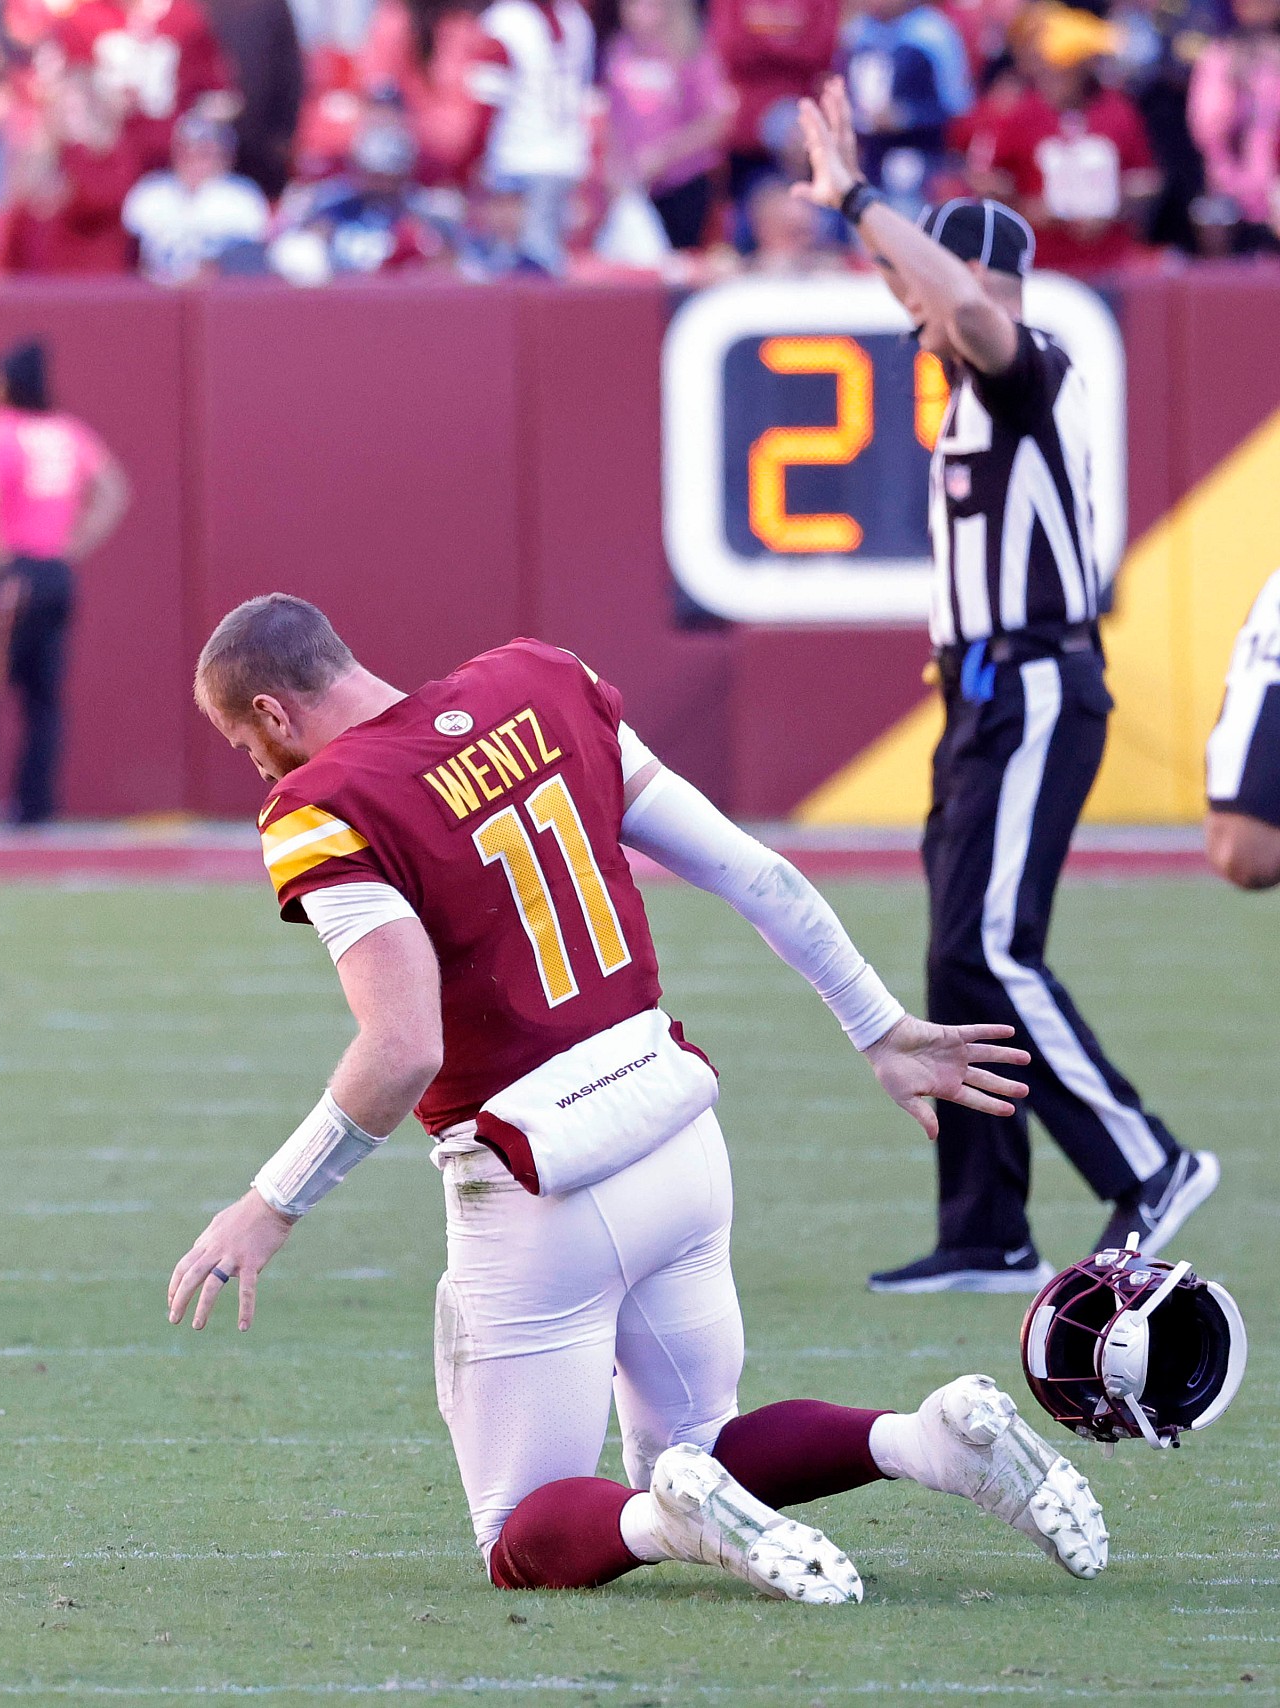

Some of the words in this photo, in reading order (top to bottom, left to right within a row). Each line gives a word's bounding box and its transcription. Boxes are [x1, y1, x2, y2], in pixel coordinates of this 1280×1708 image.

[423, 708, 562, 820] WENTZ
[471, 773, 632, 1009] 11
[555, 1052, 658, 1109] WASHINGTON
